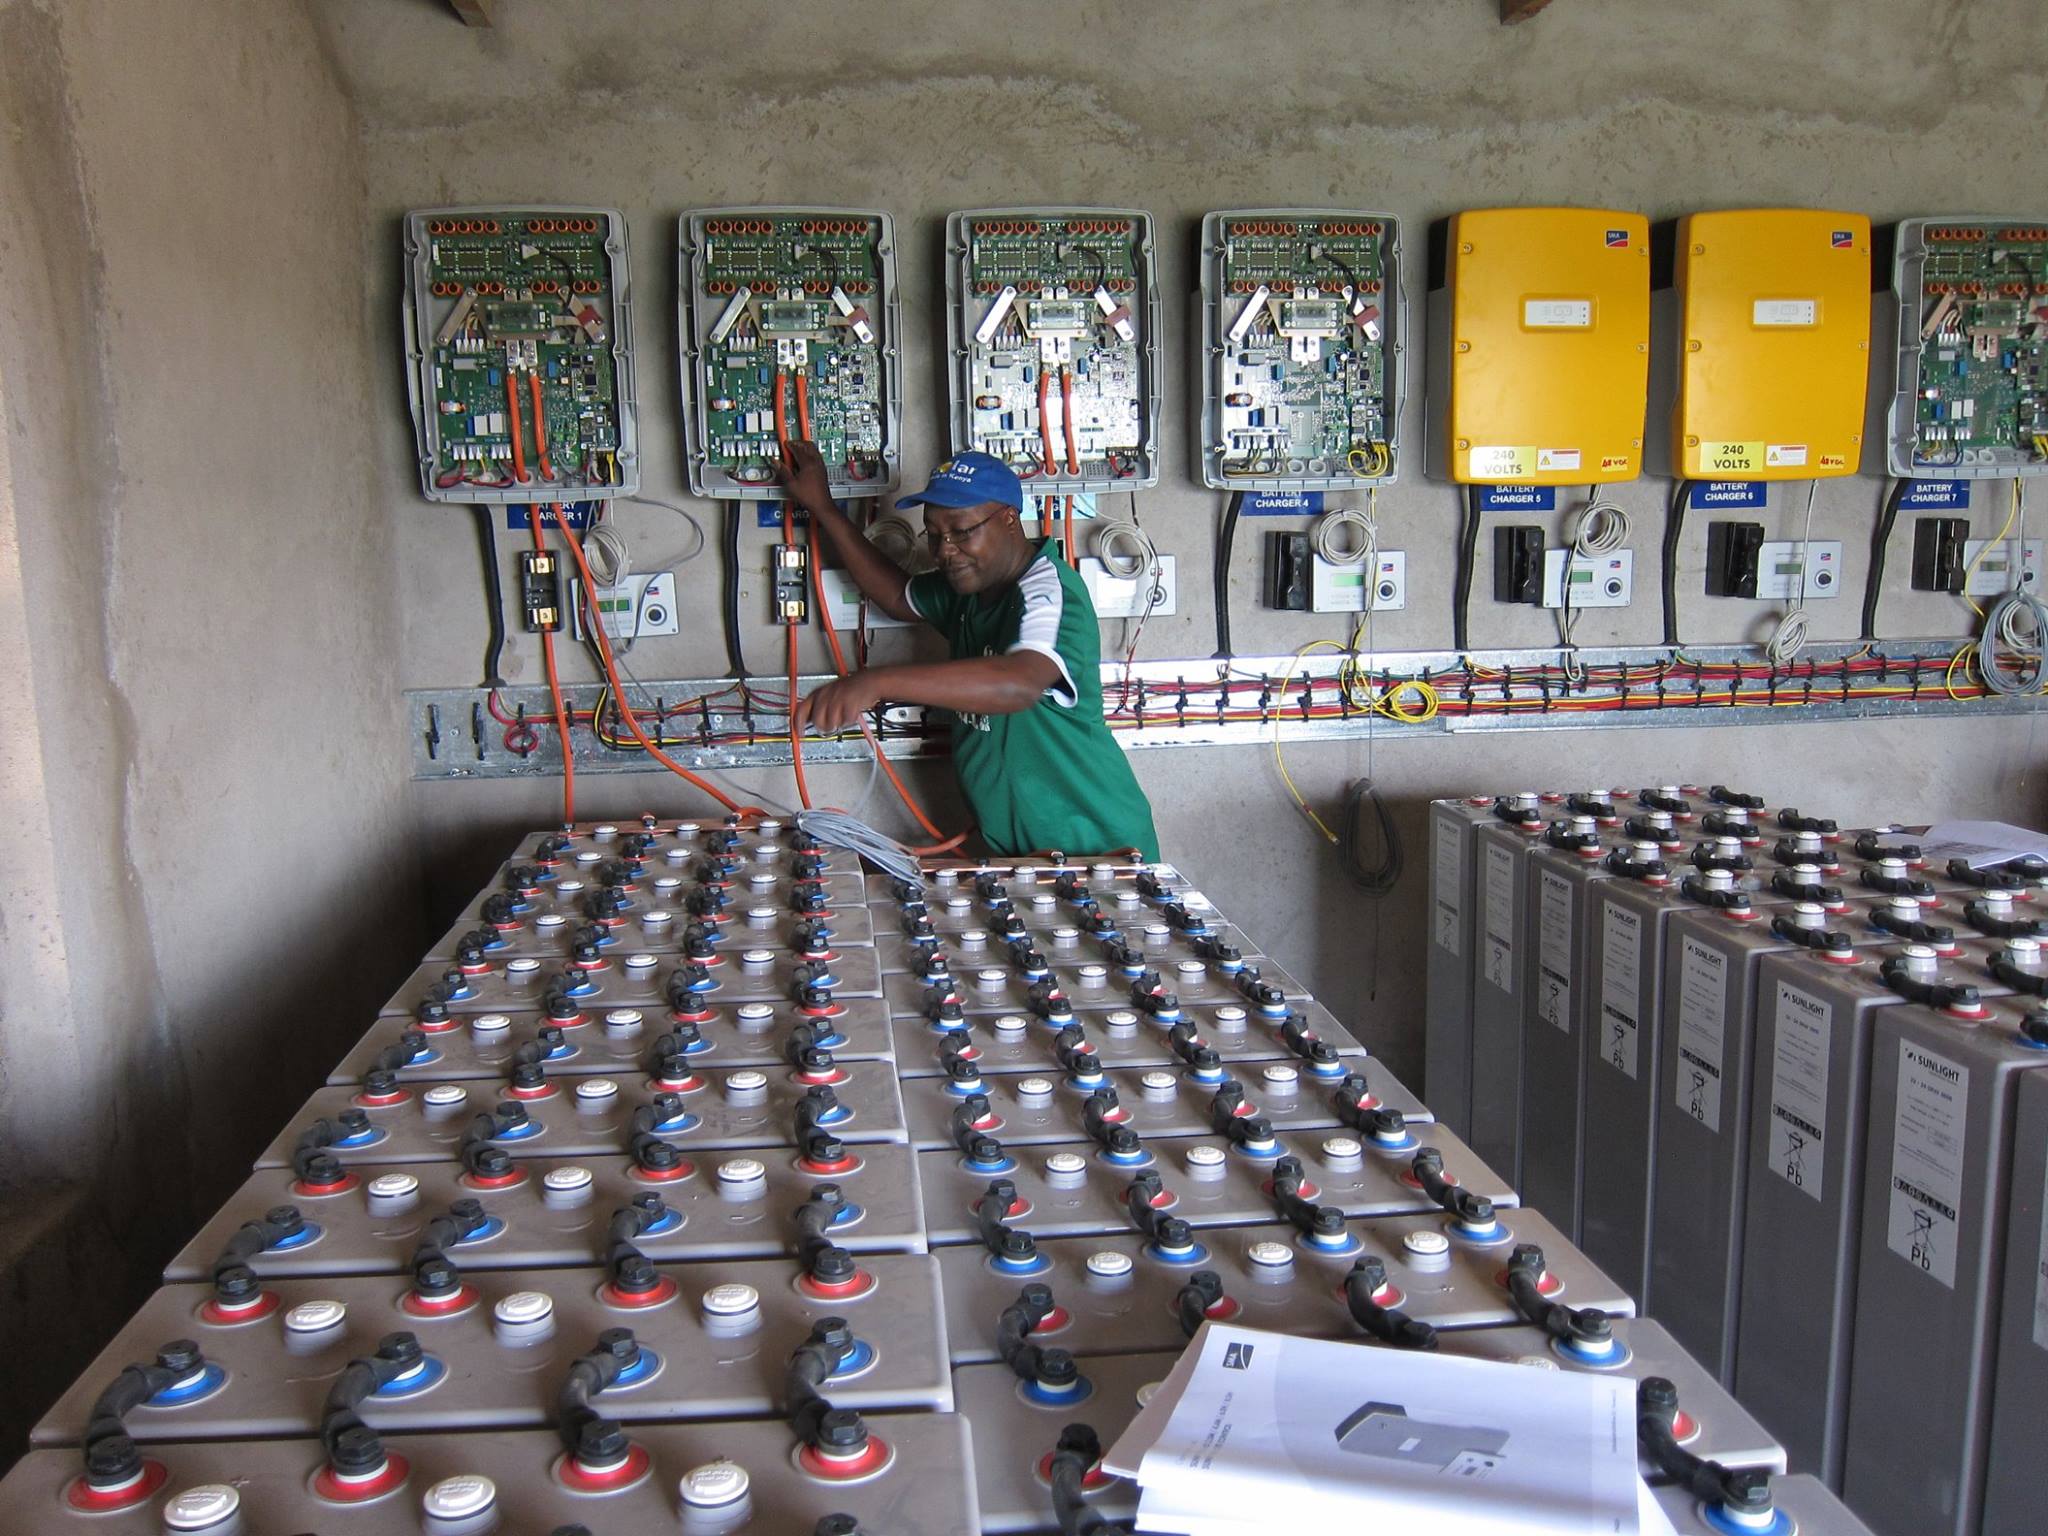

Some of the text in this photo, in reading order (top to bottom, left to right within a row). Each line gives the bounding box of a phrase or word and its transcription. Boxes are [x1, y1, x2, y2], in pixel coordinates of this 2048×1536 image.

[1493, 450, 1515, 460] 240
[1722, 445, 1744, 455] 240
[1484, 464, 1523, 474] VOLTS
[1714, 459, 1750, 469] VOLTS
[1710, 482, 1749, 491] BATTERY
[1916, 484, 1953, 493] BATTERY
[1490, 494, 1541, 503] CHARGER 5
[1705, 492, 1754, 501] CHARGER 6
[1911, 493, 1957, 502] CHARGER 7
[1255, 499, 1309, 508] CHARGER 4
[577, 511, 582, 520] 1
[1694, 947, 1721, 967] SUNLIGHT
[1792, 994, 1824, 1016] SUNLIGHT
[1918, 1055, 1960, 1082] SUNLIGHT
[1691, 1100, 1703, 1120] Pb
[1786, 1164, 1802, 1186] Pb
[1911, 1245, 1930, 1271] Pb
